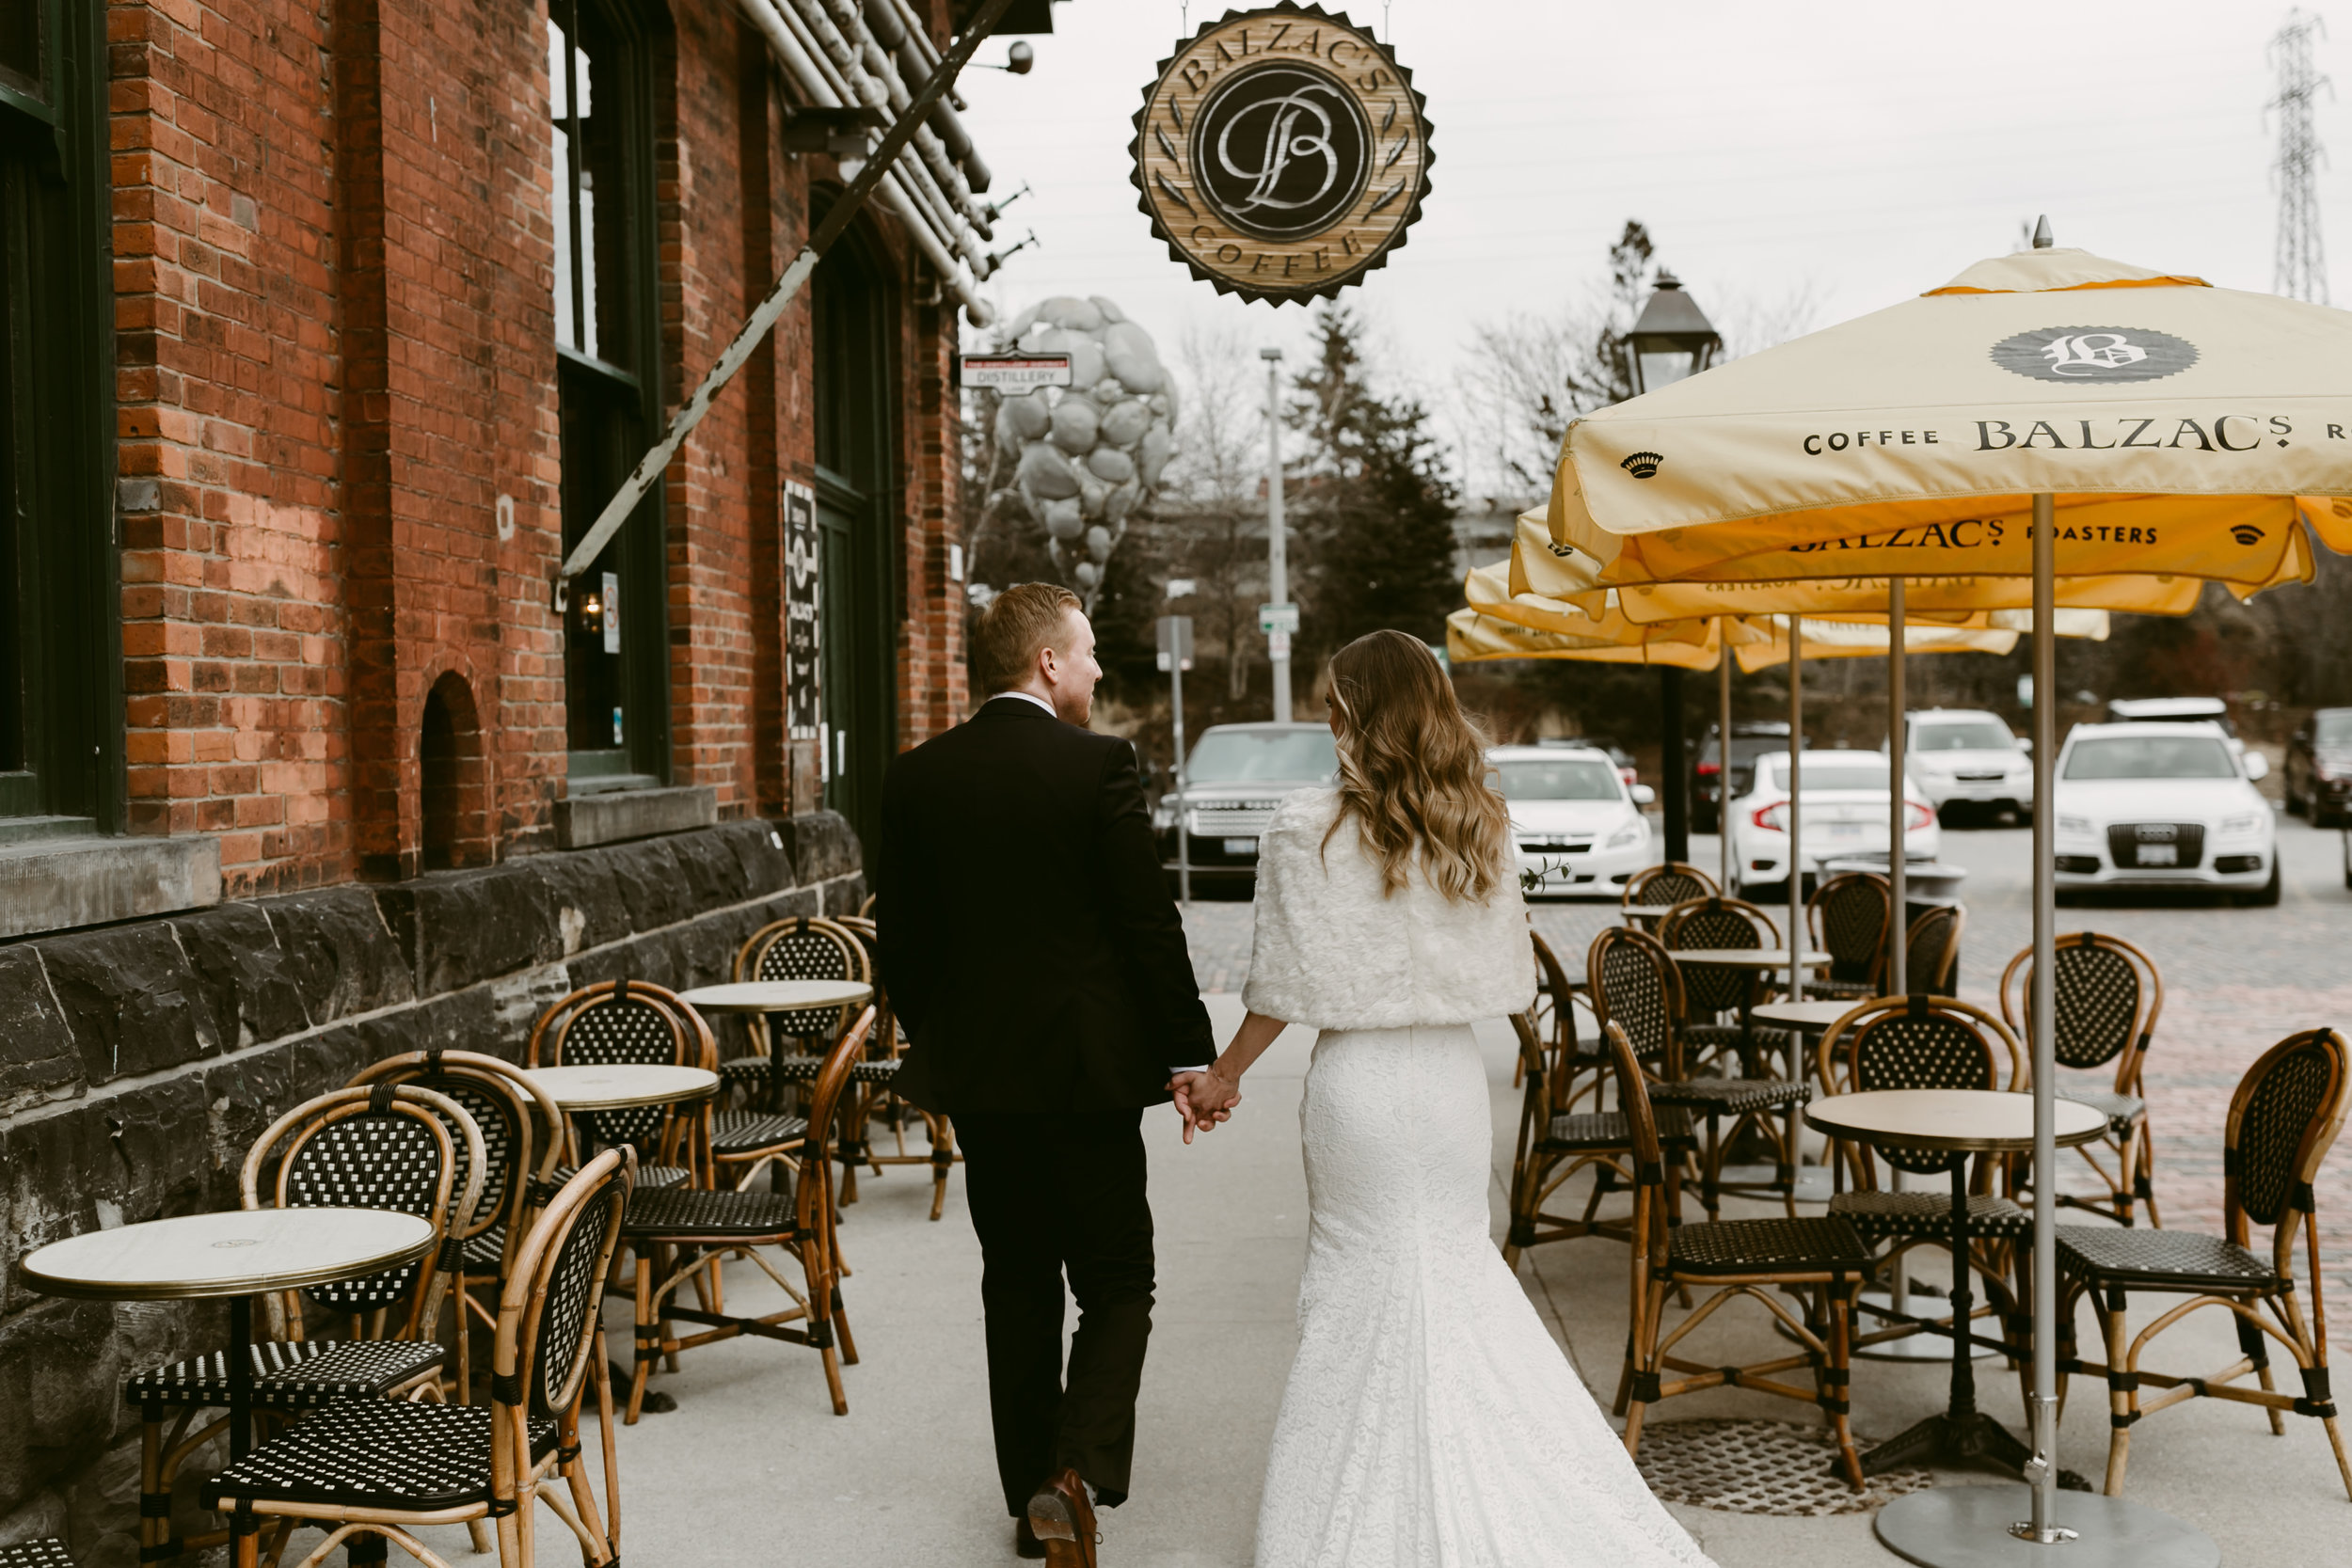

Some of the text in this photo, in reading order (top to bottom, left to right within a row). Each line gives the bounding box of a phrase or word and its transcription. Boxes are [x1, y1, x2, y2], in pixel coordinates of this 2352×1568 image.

[1178, 23, 1391, 94] BALZAC'S
[1190, 224, 1364, 277] COFFEE
[1804, 430, 1939, 456] COFFEE
